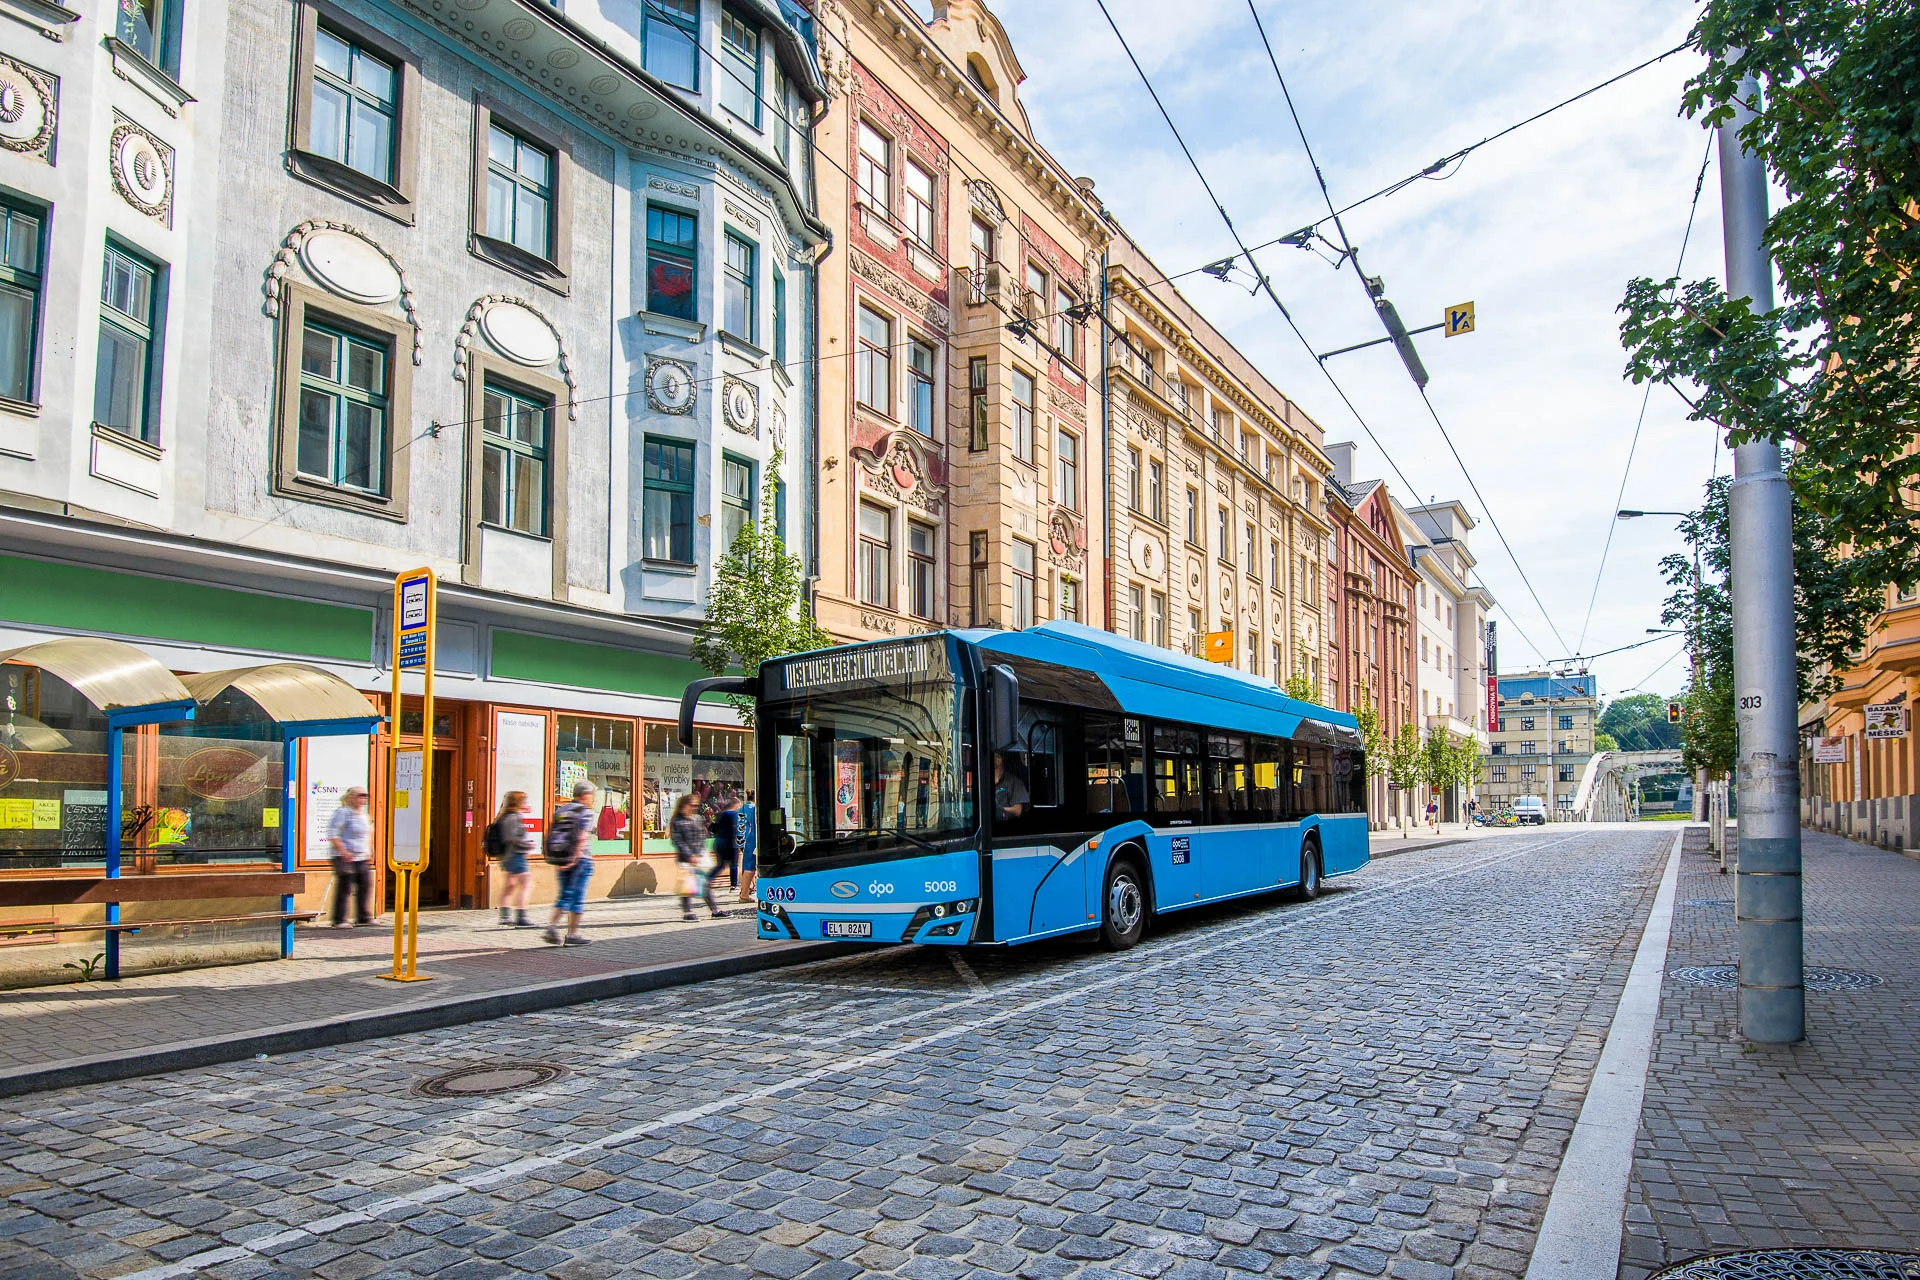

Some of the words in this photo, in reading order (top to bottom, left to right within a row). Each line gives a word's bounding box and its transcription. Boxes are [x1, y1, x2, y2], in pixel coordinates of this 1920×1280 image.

[1461, 320, 1471, 330] A
[1740, 695, 1762, 710] 303
[1867, 705, 1903, 713] BAZARY
[594, 760, 620, 772] nápoje
[664, 763, 690, 774] mléčné
[663, 774, 690, 786] výrobky
[1173, 854, 1185, 864] 5008
[924, 880, 957, 893] 5008
[828, 923, 843, 934] EL1
[847, 923, 867, 934] 82AY
